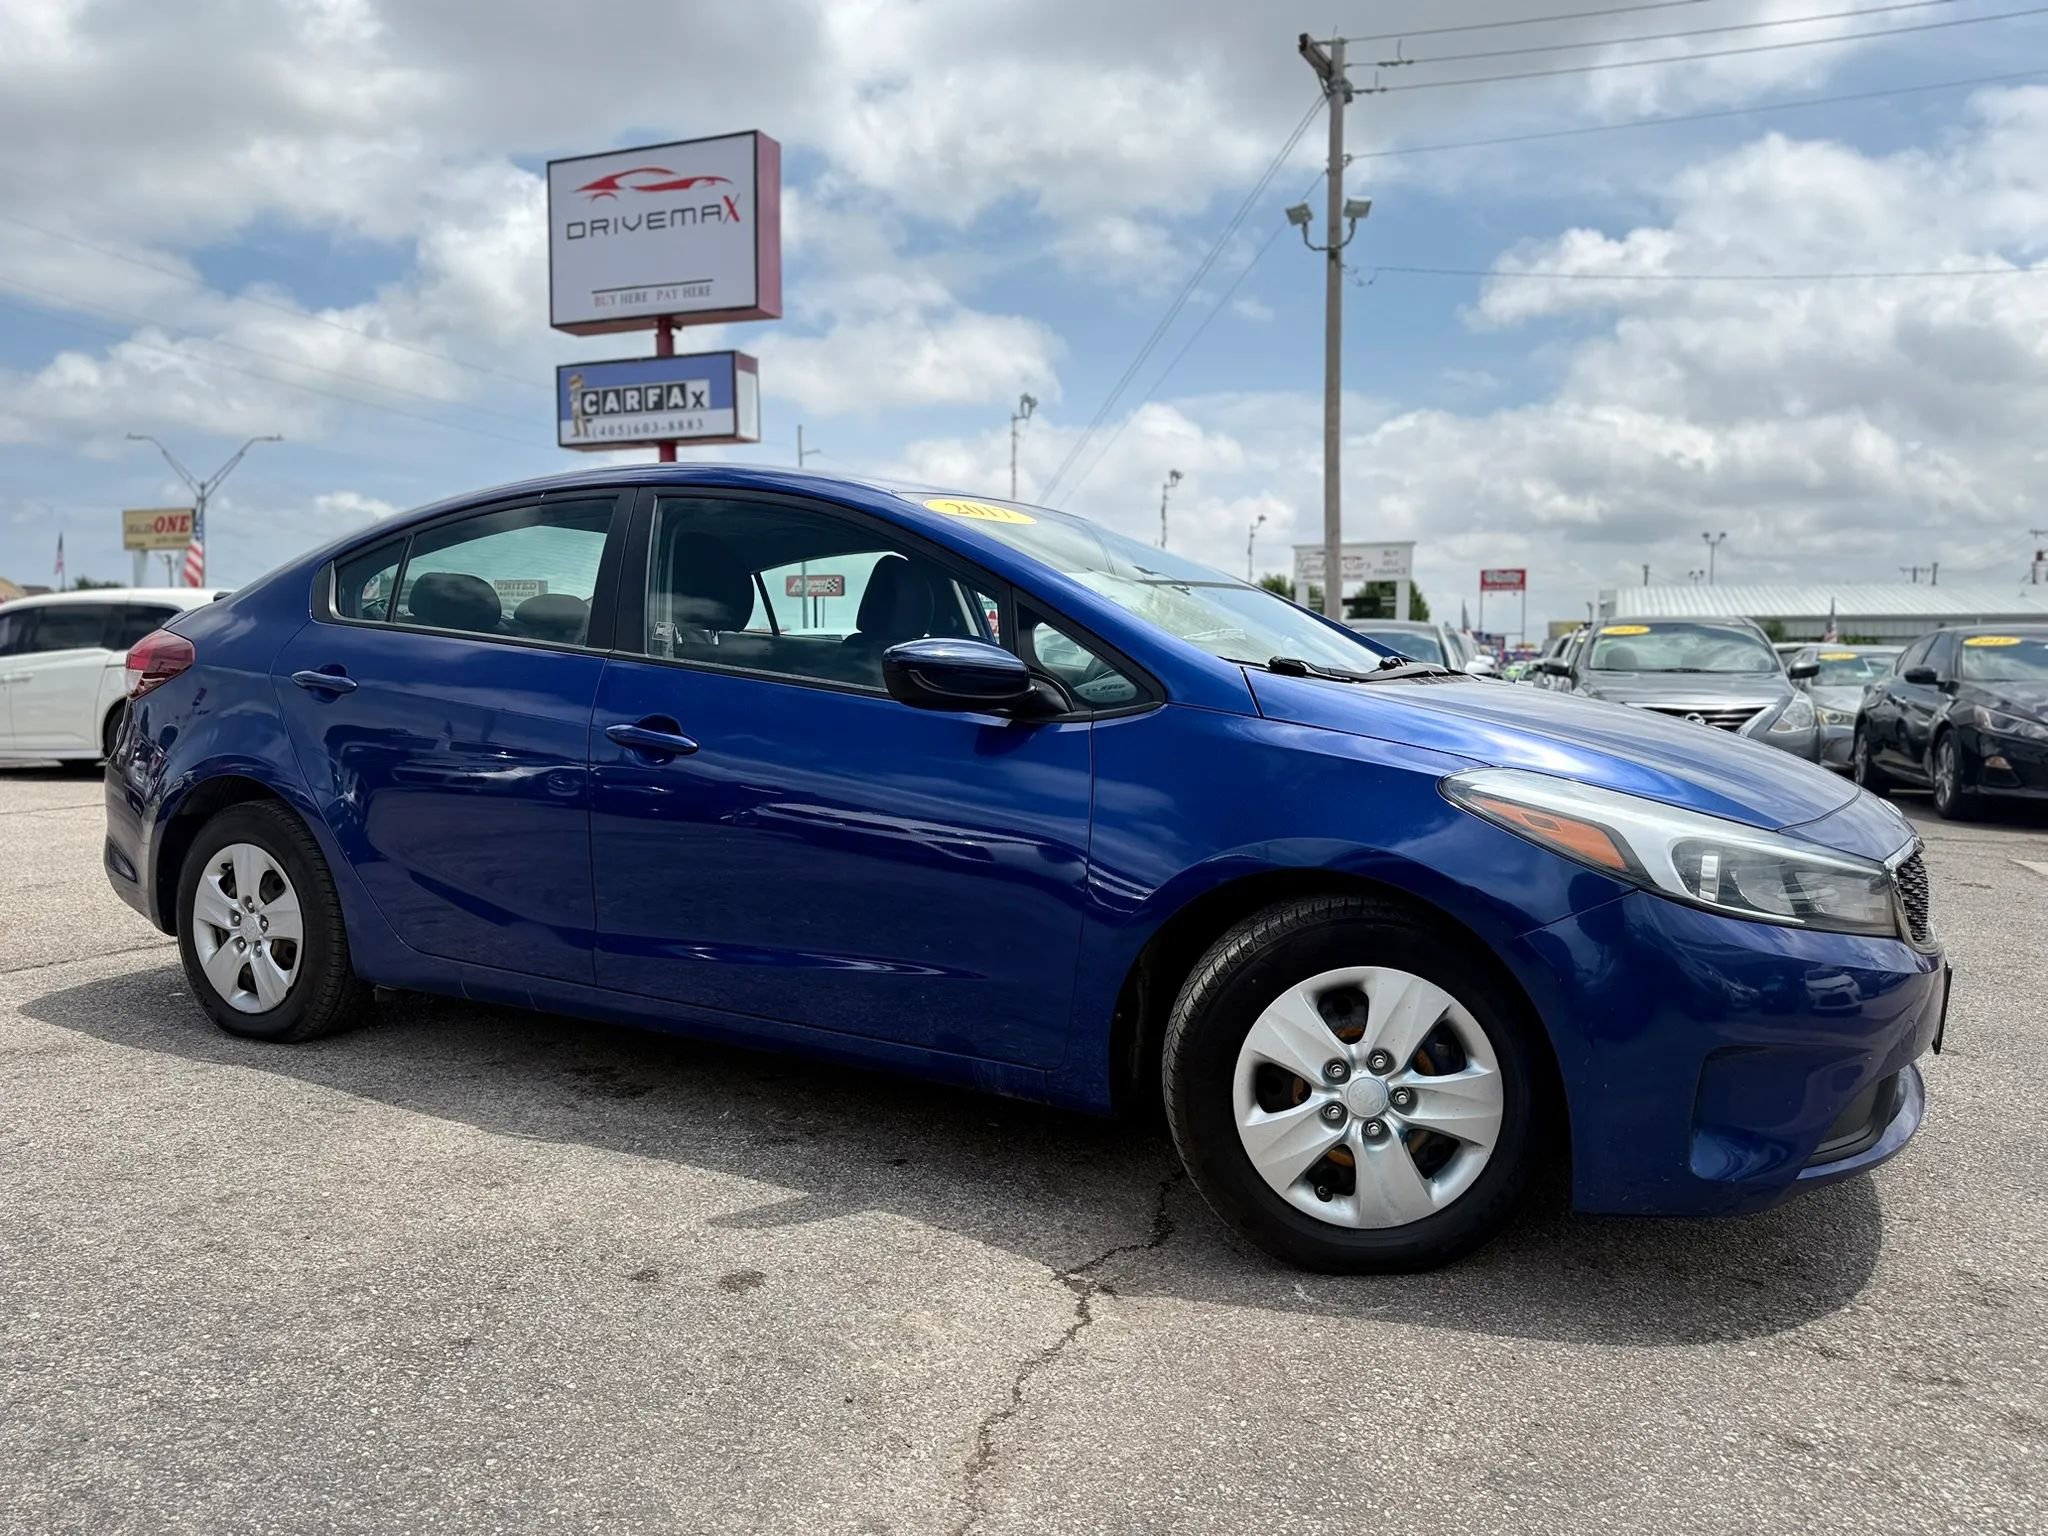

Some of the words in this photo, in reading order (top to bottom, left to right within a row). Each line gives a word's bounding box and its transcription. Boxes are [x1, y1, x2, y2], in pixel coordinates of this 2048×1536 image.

[594, 294, 617, 307] BUY
[620, 291, 648, 304] HERE
[657, 288, 680, 301] PAY
[683, 285, 712, 298] HERE
[944, 502, 1012, 520] 2017
[154, 515, 190, 534] ONE
